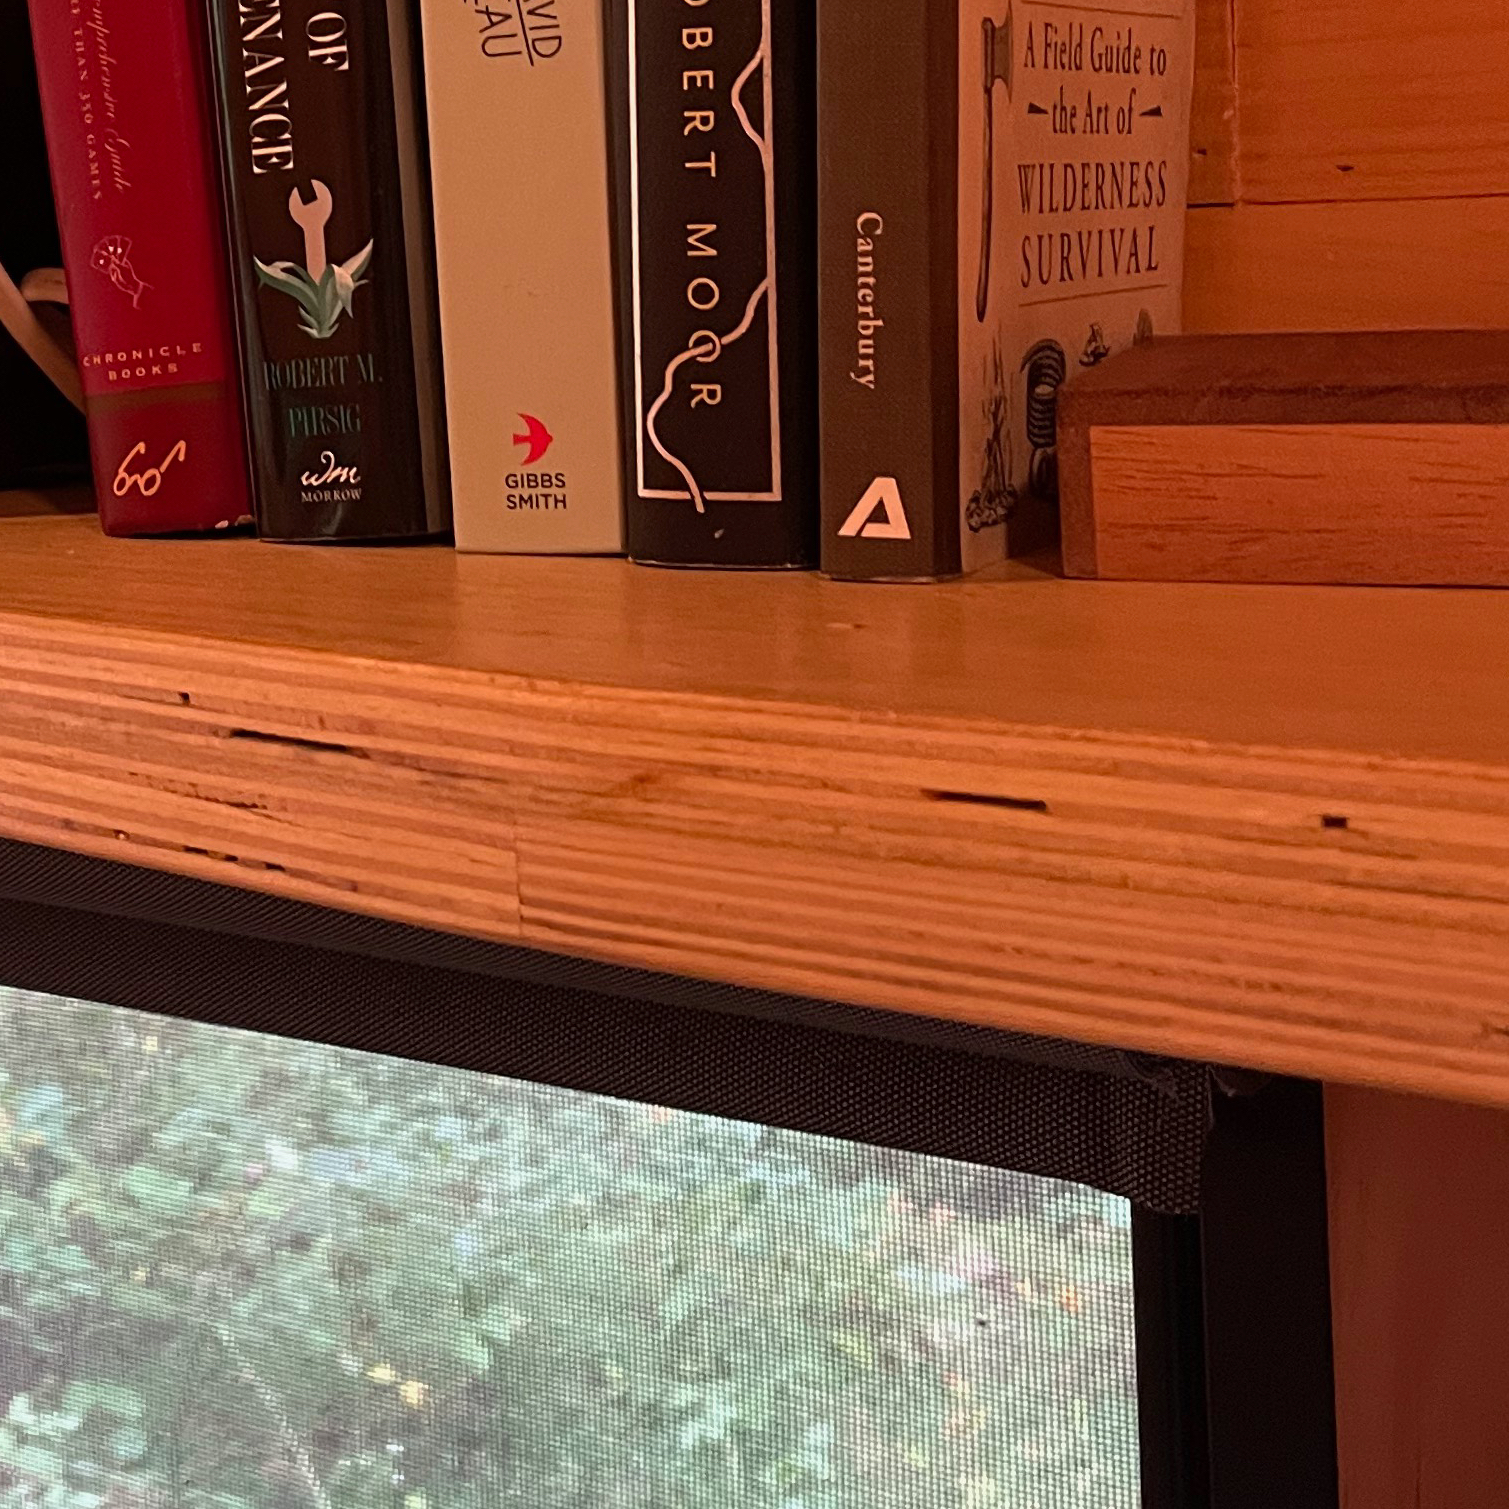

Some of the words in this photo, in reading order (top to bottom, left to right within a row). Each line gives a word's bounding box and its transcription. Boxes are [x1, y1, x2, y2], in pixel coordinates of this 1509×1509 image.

[306, 11, 350, 71] OF
[1024, 21, 1035, 68] A
[1043, 21, 1083, 71] Field
[1091, 26, 1141, 75] Guide
[1149, 44, 1167, 76] to
[74, 29, 89, 81] THAN
[87, 133, 102, 200] GAMES
[1052, 85, 1076, 134] the
[1086, 89, 1109, 134] Art
[1116, 87, 1136, 135] of
[1017, 160, 1167, 215] WILDERNESS
[1020, 225, 1158, 288] SURVIVAL
[686, 224, 722, 408] MOOR
[850, 212, 884, 389] Canterbury
[83, 343, 202, 367] CHRONICLE
[108, 363, 178, 381] BOOKS
[263, 354, 350, 391] ROBERT
[357, 353, 383, 384] M.
[289, 404, 362, 438] PIRSIG
[301, 487, 362, 503] MORROW
[505, 473, 566, 488] GIBBS
[507, 494, 567, 510] SMITH
